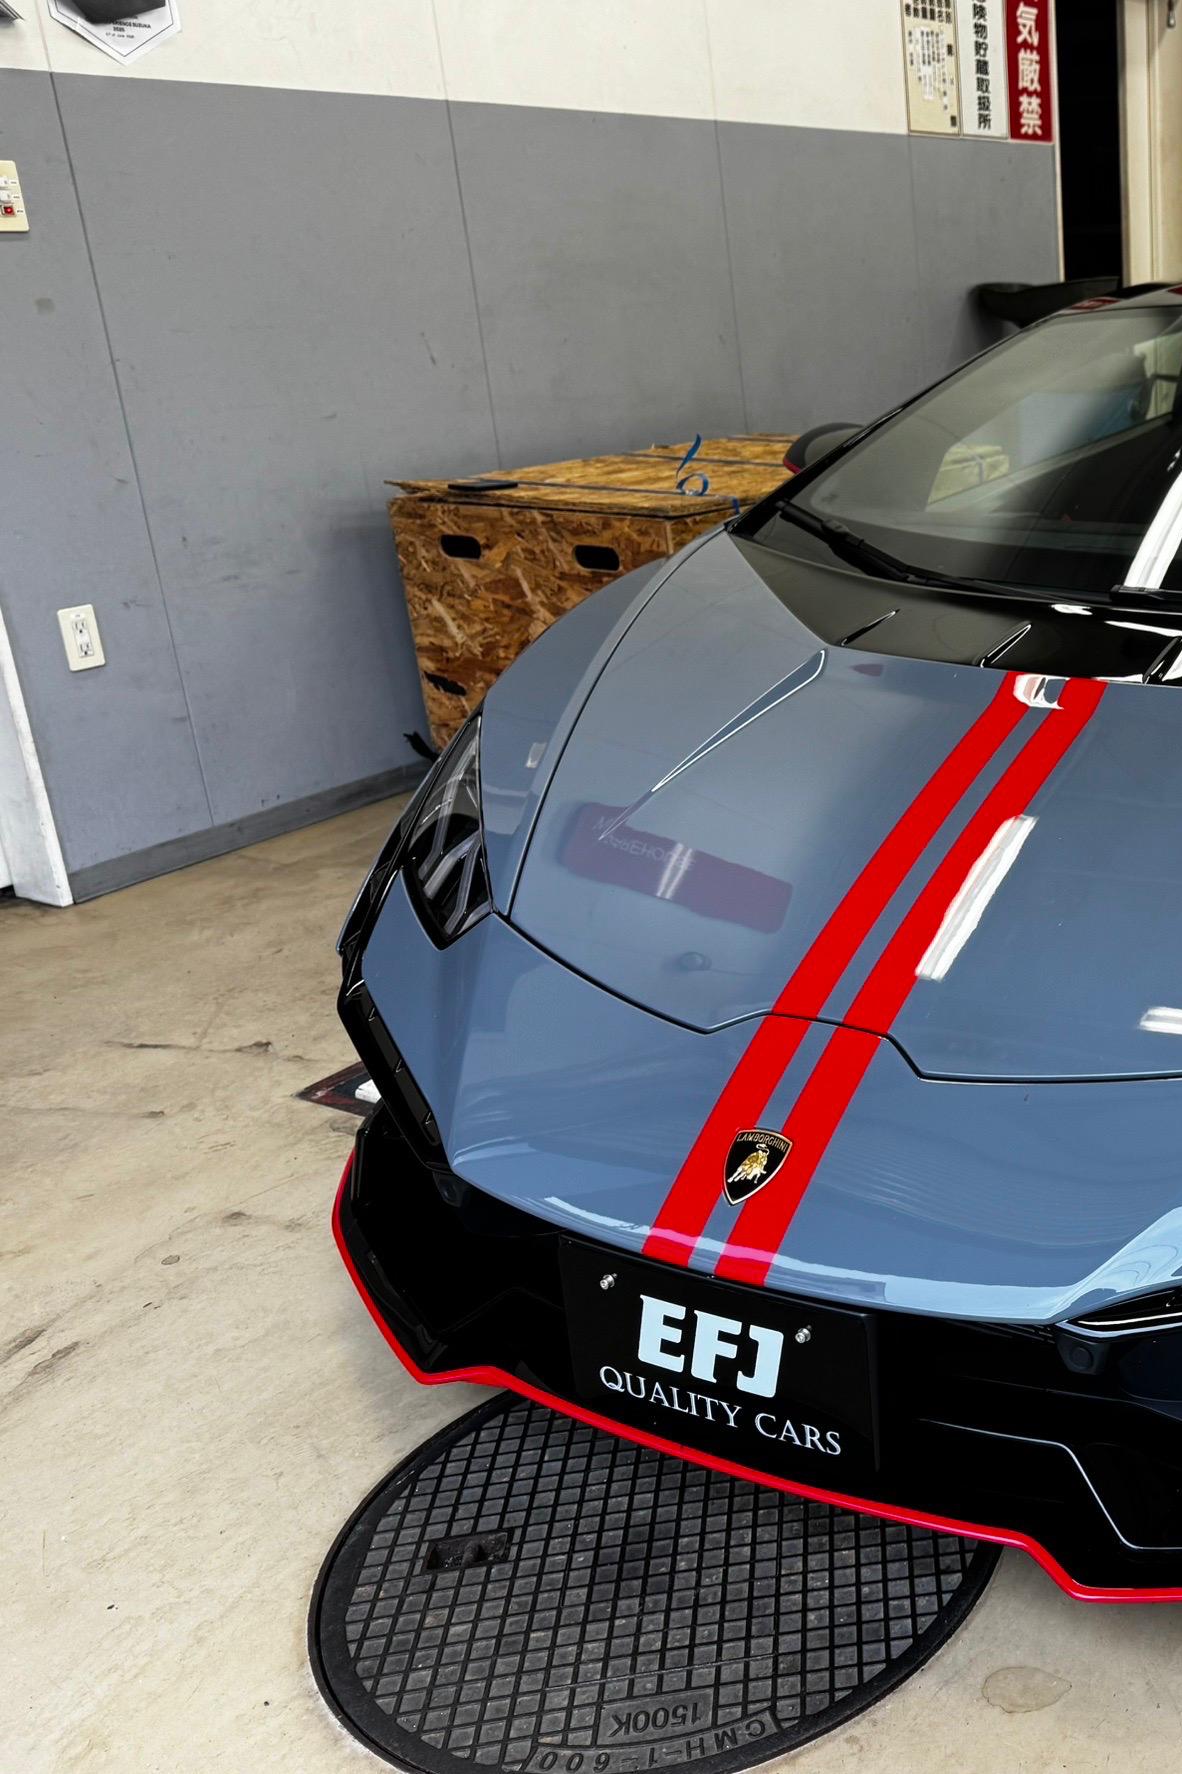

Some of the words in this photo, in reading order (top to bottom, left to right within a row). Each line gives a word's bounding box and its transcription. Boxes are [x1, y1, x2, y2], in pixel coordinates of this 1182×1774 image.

[972, 0, 991, 130] 険物貯蔵取扱所
[1016, 0, 1042, 136] 気厳禁
[736, 1132, 789, 1153] LAMBORGHINI
[637, 1294, 784, 1398] EFJ
[599, 1365, 742, 1428] QUALITY
[754, 1412, 842, 1455] CARS
[607, 1701, 699, 1737] 1500K
